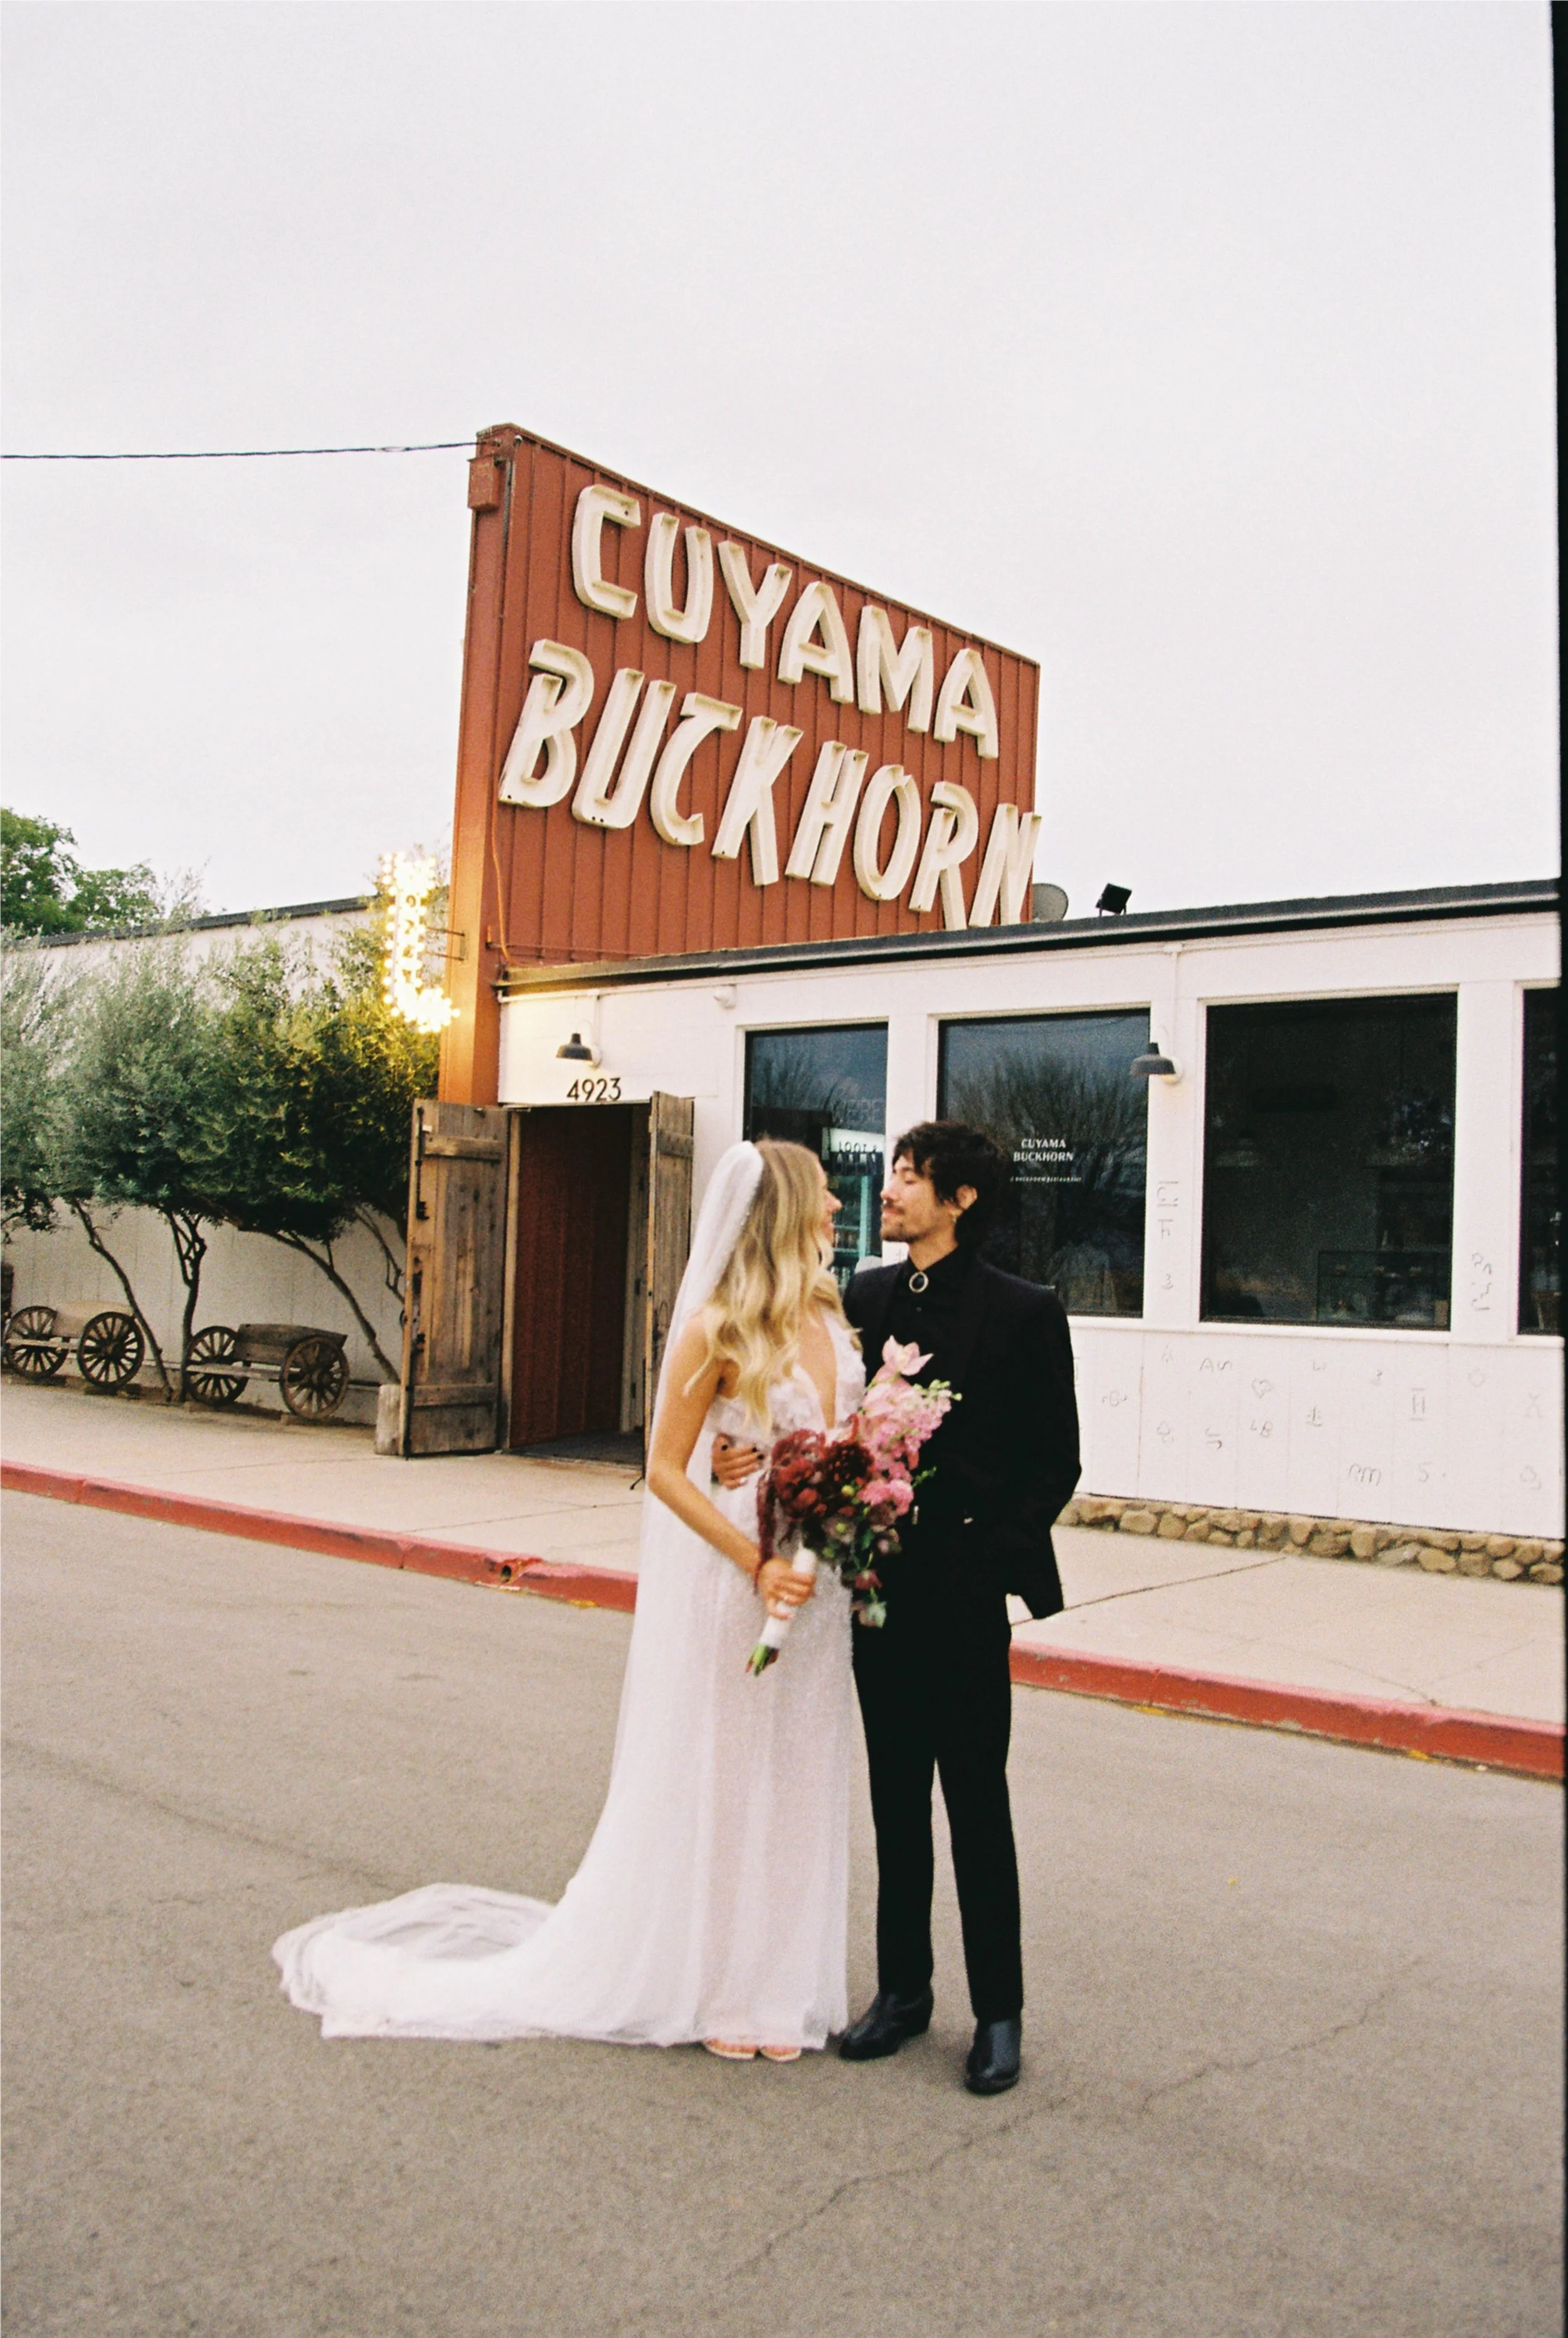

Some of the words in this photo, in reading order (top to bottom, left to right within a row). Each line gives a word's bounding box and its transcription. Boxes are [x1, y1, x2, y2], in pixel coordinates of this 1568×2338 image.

[572, 484, 999, 759] CUYAMA
[499, 639, 1042, 932] BUCKHORN
[566, 1077, 621, 1102] 4923
[1020, 1138, 1066, 1149] CUYAMA
[1013, 1151, 1074, 1162] BUCKHORN
